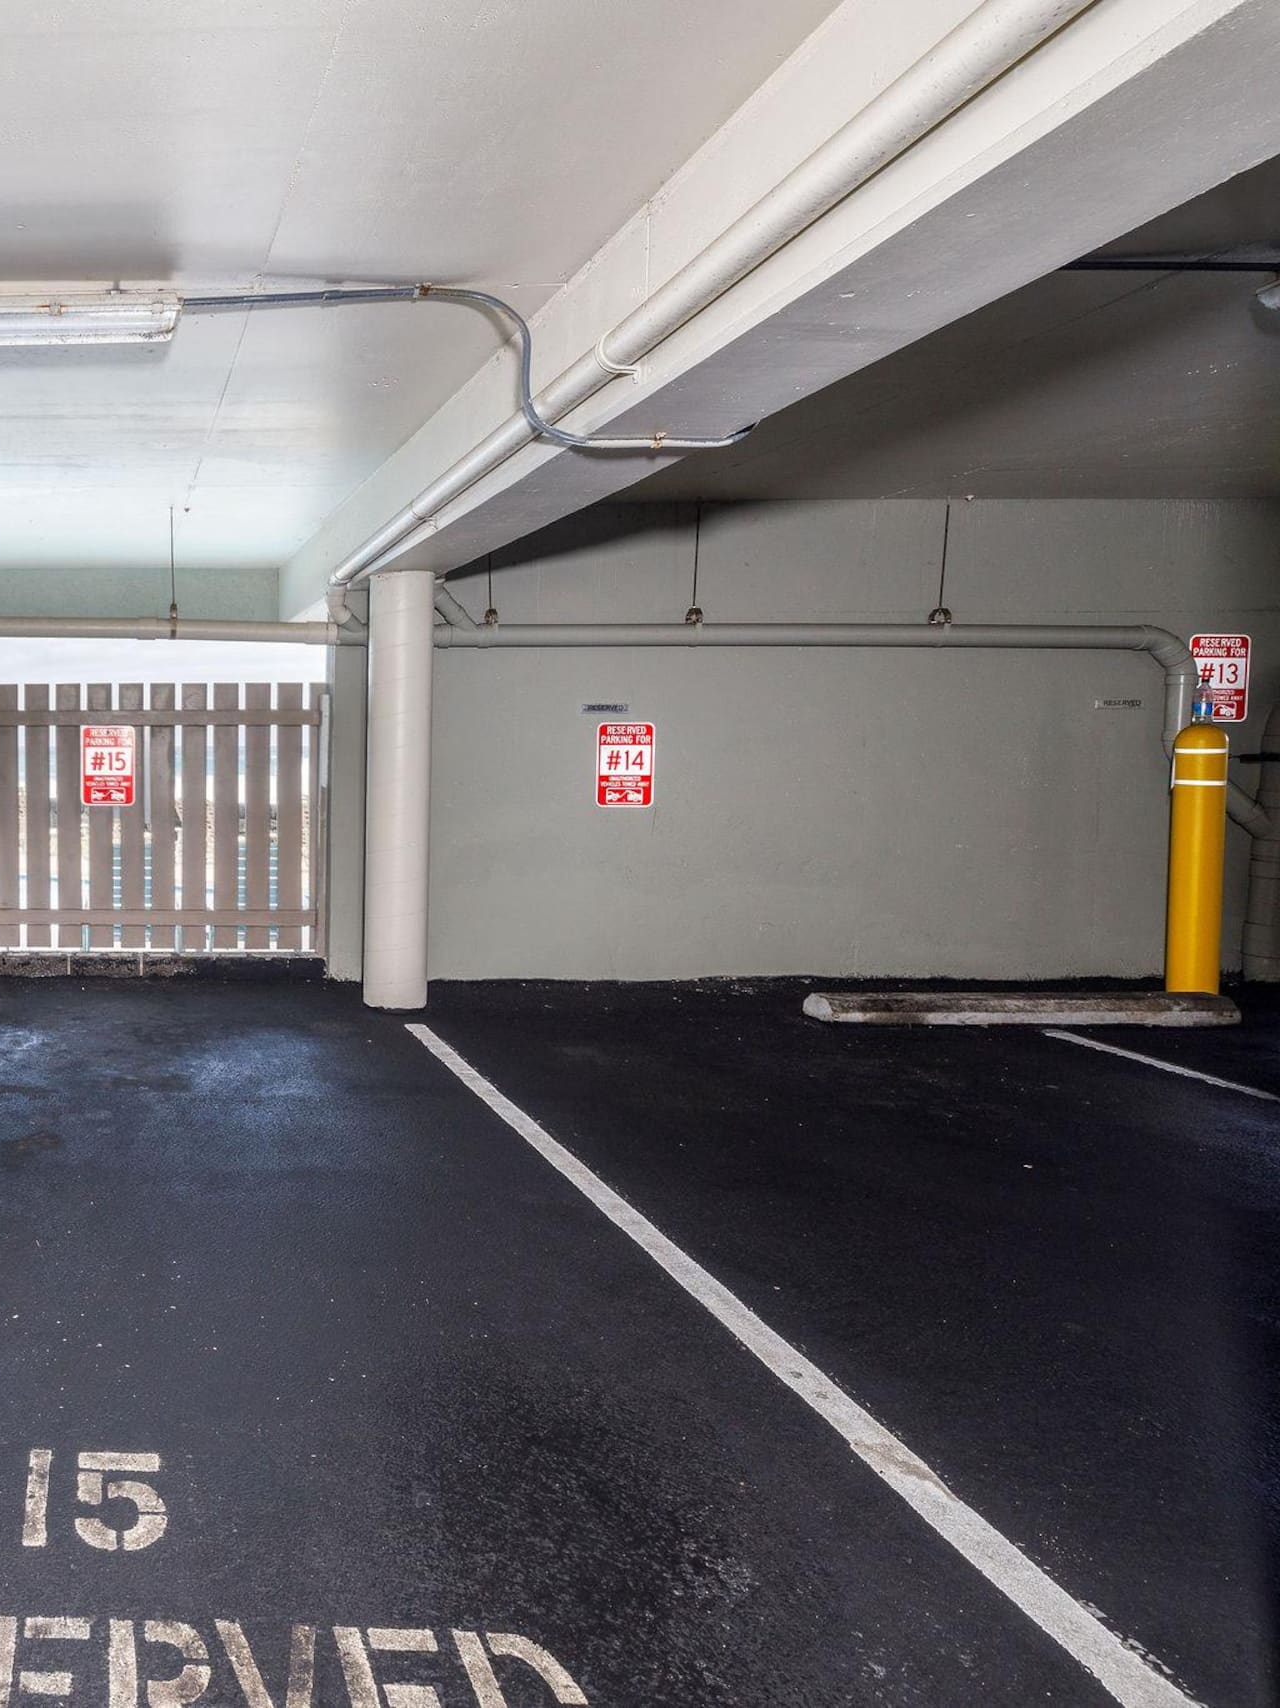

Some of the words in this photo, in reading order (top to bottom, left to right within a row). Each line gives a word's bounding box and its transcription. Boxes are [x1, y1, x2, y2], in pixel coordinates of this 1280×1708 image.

[1200, 638, 1242, 647] RESERVED
[1193, 648, 1227, 656] PARKING
[1231, 648, 1246, 656] FOR
[1199, 663, 1238, 684] #13
[1104, 699, 1141, 707] RESERVED
[587, 704, 624, 712] RESERVED
[606, 726, 647, 735] RESERVED
[601, 735, 633, 744] PARKING
[636, 735, 651, 744] FOR
[91, 751, 126, 771] #15
[606, 750, 644, 771] #14
[21, 1448, 167, 1552] 15
